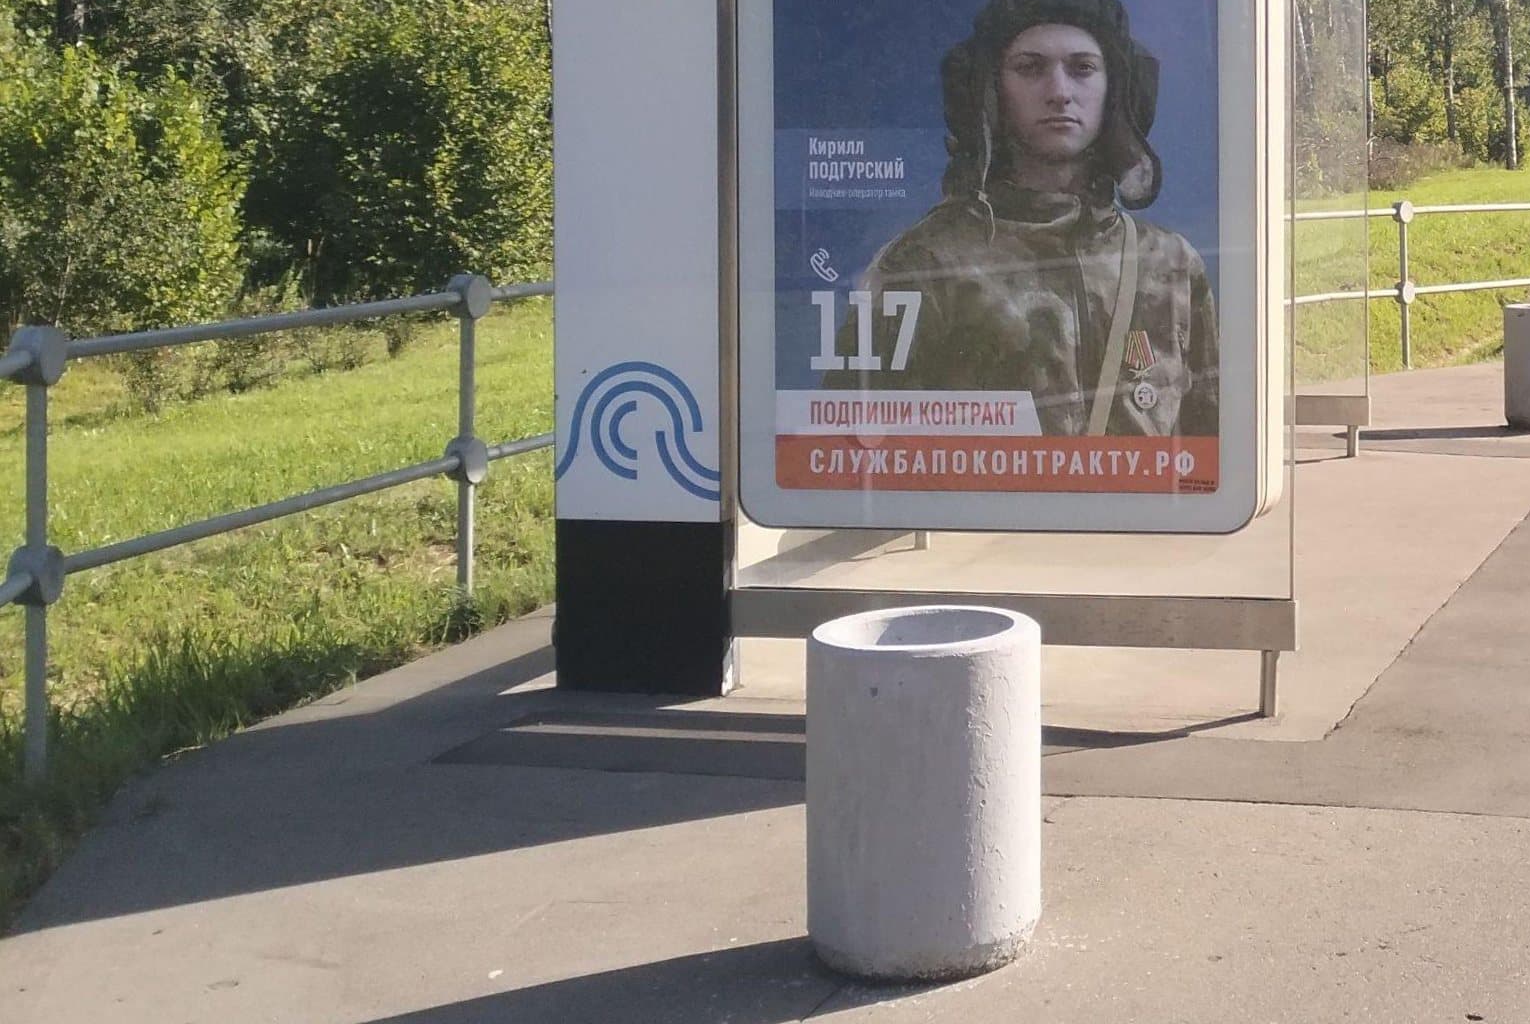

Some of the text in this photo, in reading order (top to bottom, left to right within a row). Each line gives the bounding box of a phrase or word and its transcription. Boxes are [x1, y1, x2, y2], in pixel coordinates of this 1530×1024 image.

[809, 137, 864, 159] Кирилл
[809, 157, 904, 182] ПОДГУРСКИЙ
[810, 291, 922, 370] 117
[810, 401, 1018, 427] ПОДПИШИ КОНТРАКТ
[810, 449, 1195, 476] СЛУЖБАПОКОНТРАКТУ.РФ
